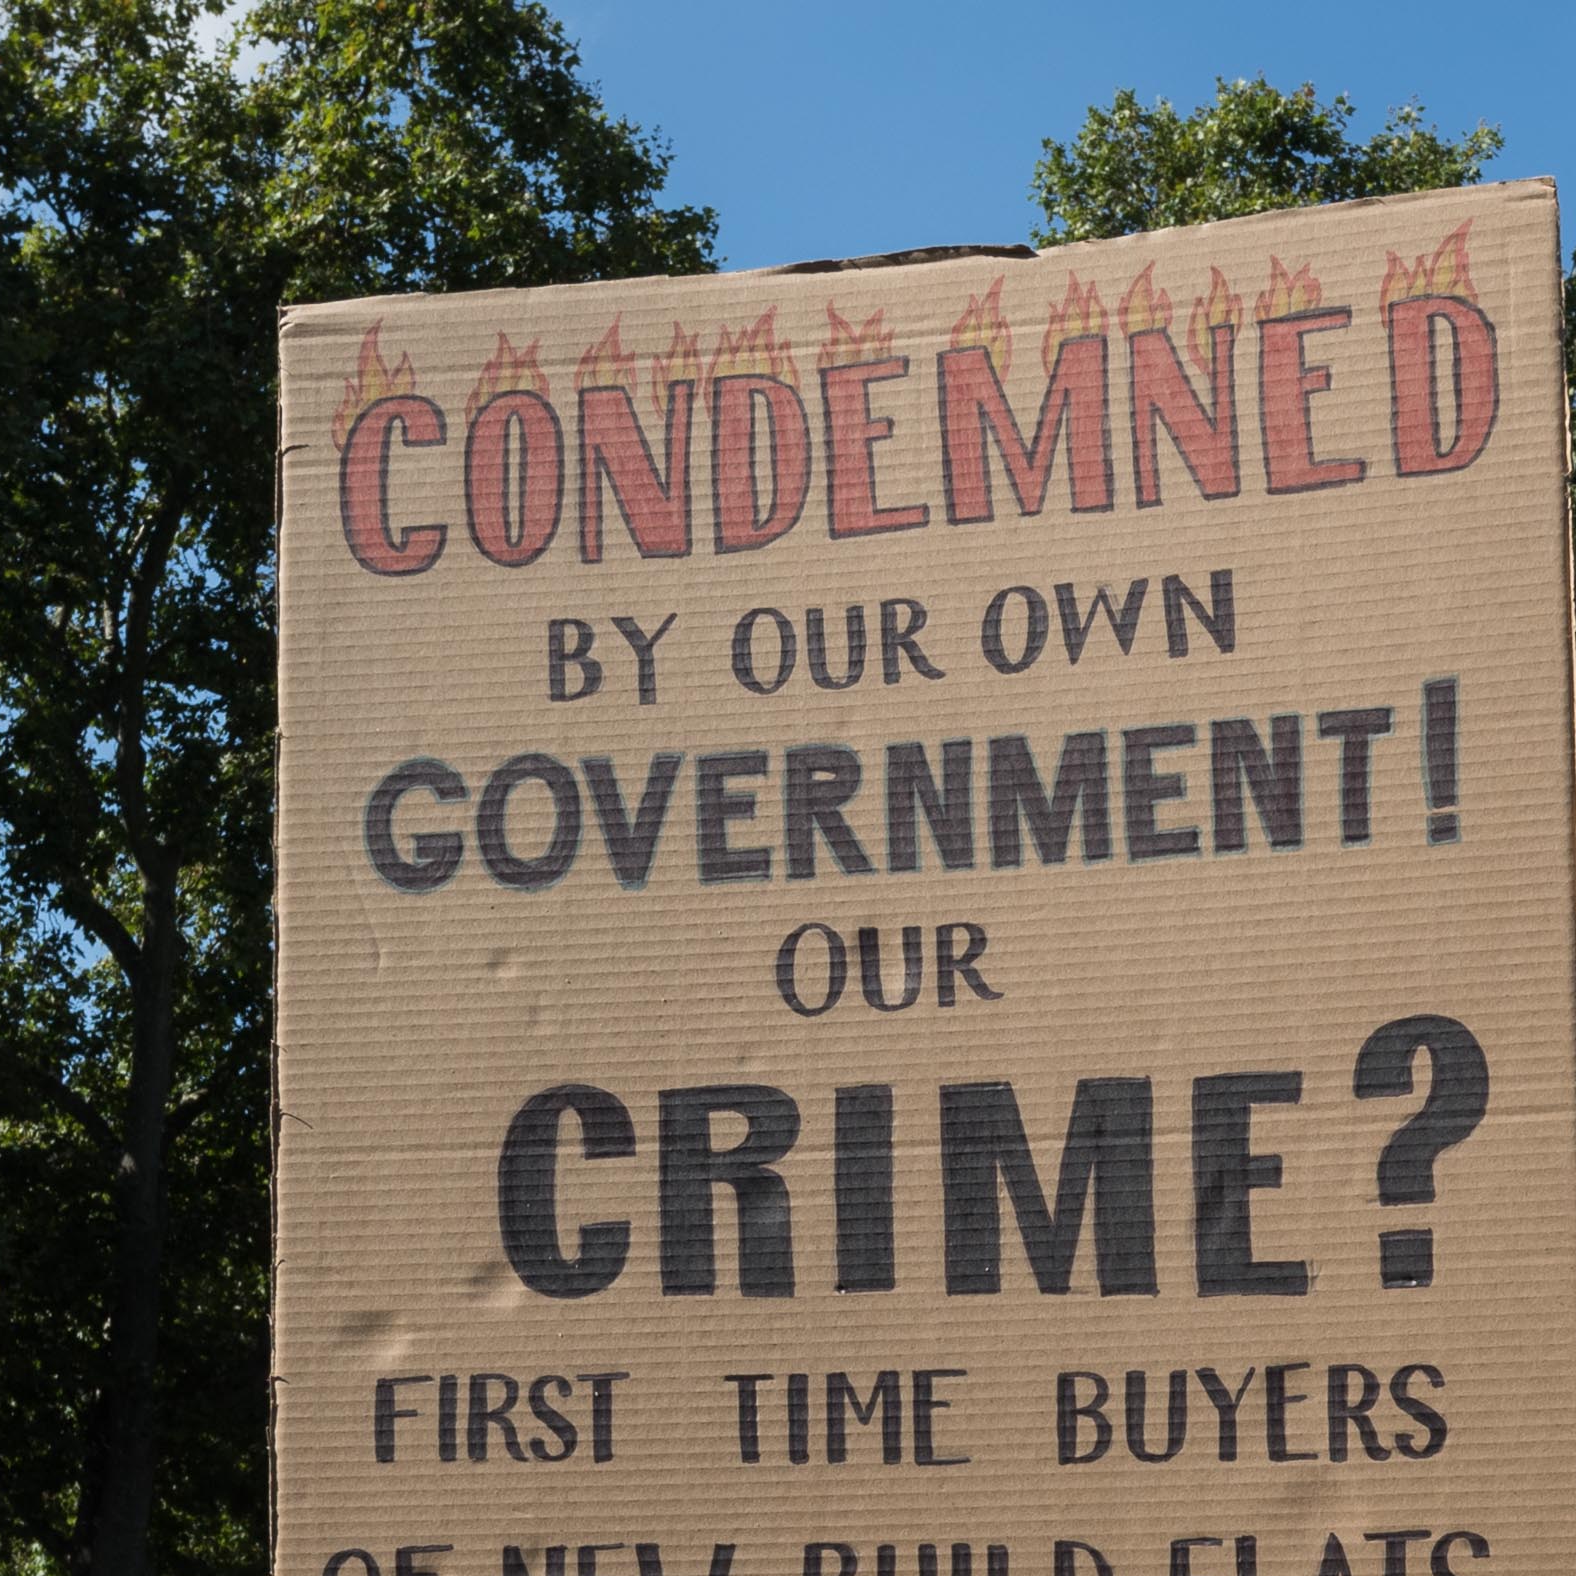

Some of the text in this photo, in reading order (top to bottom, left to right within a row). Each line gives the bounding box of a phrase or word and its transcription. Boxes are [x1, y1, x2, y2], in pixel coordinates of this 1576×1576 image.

[340, 295, 1499, 576] CONDEMNED
[548, 569, 1235, 705] BY OUR OWN
[364, 678, 1460, 892] GOVERNMENT!
[777, 922, 1002, 1016] OUR
[498, 1015, 1491, 1299] CRIME?
[375, 1362, 1448, 1465] FIRST TIME BUYERS
